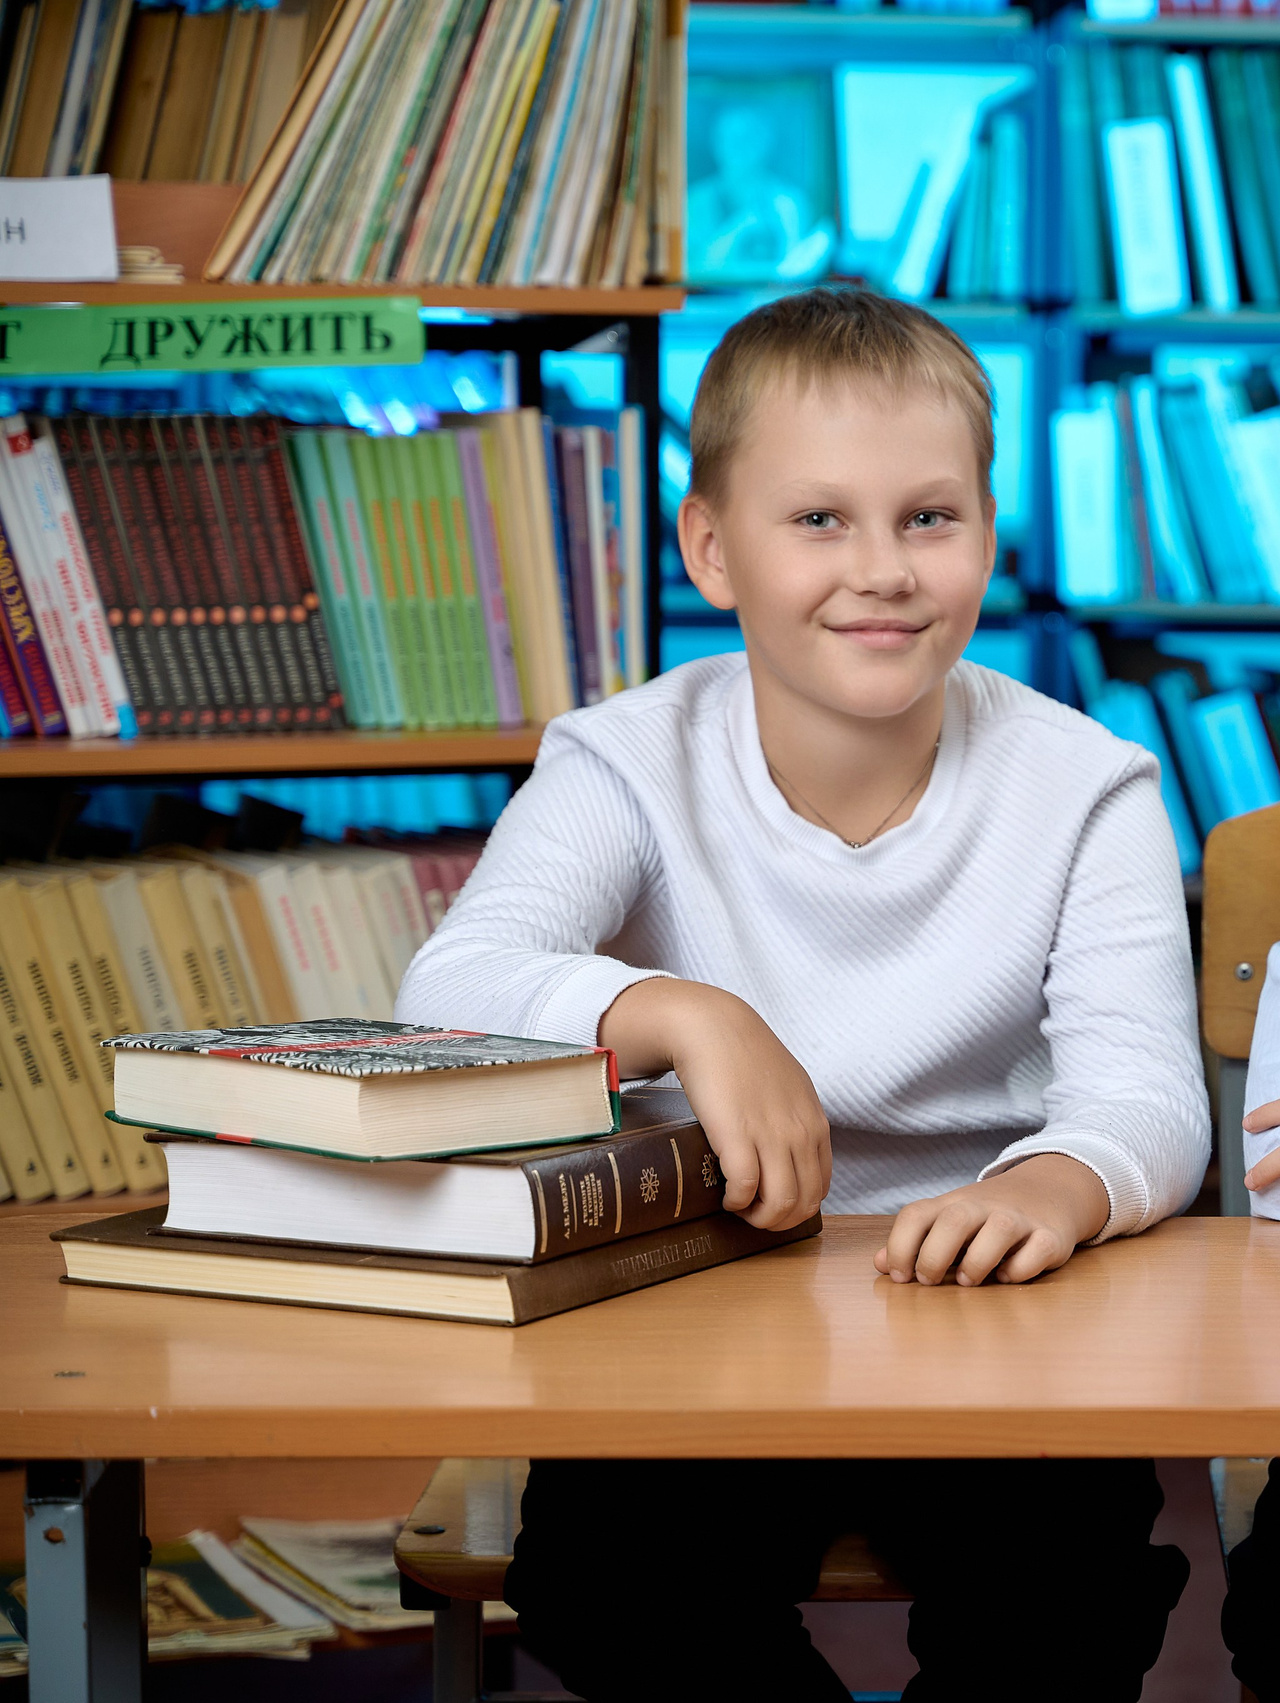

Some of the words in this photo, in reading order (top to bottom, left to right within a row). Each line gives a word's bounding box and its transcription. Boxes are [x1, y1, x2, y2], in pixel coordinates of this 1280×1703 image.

[101, 310, 394, 368] ДРУЖИТЬ
[558, 1173, 571, 1214] МЕЛУА
[579, 1180, 588, 1224] ГЕОЛОГИ
[610, 1243, 681, 1277] ПУШКИНА
[684, 1234, 713, 1259] МИР
